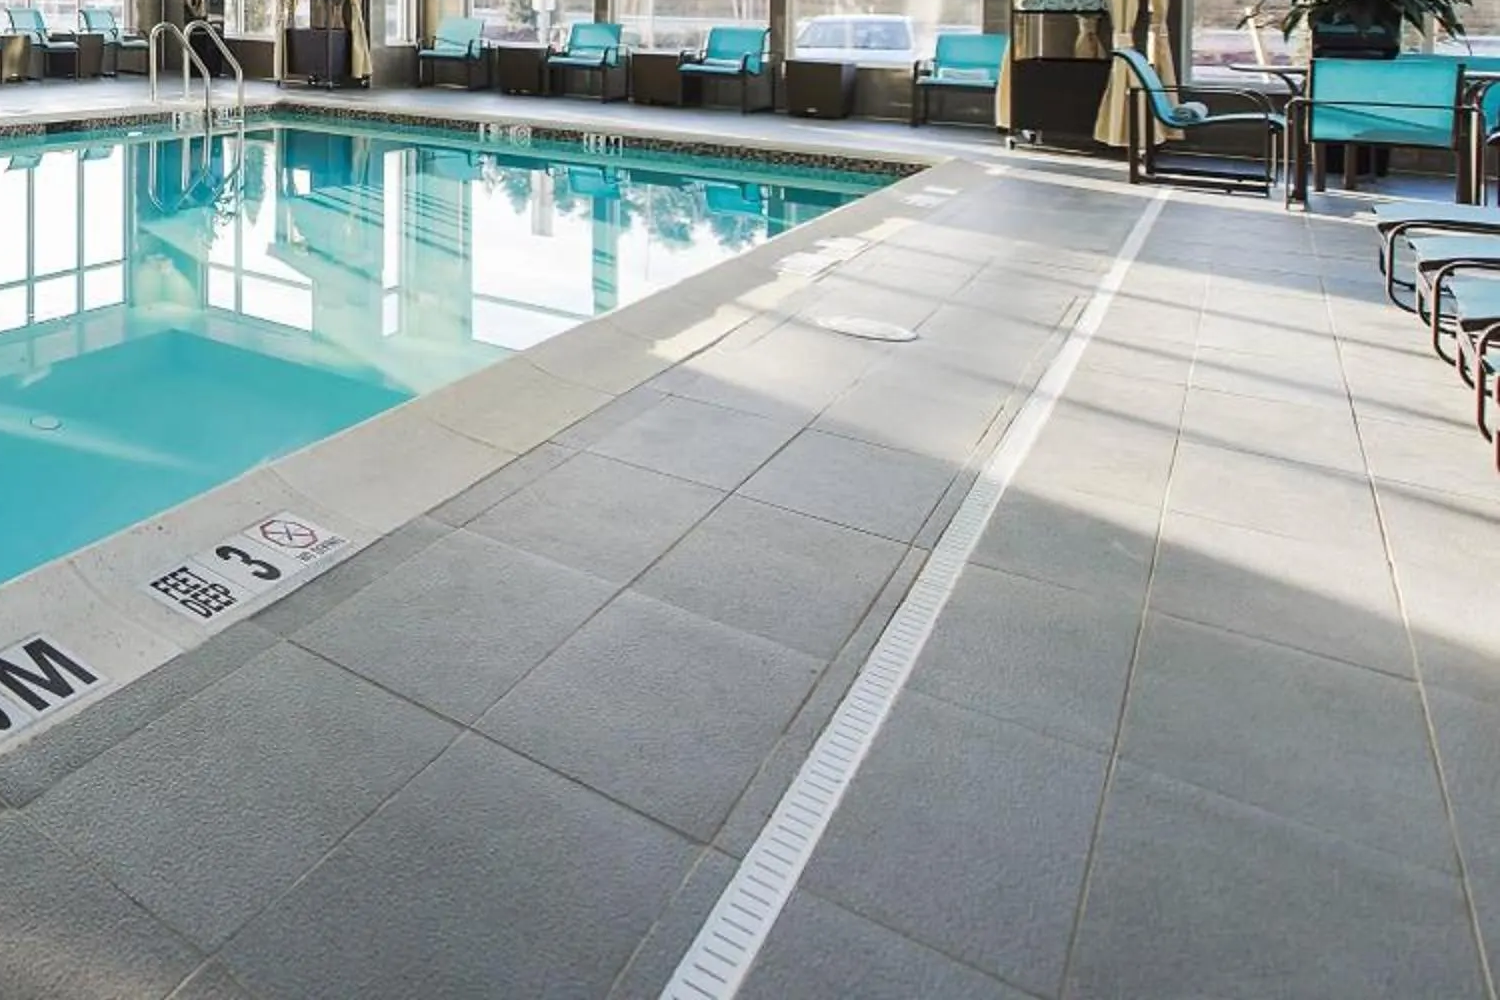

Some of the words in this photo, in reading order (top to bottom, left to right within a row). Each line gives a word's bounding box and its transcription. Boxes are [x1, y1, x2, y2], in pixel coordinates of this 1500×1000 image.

[215, 545, 281, 580] 3
[150, 566, 209, 600] FEET
[179, 583, 238, 618] DEEP
